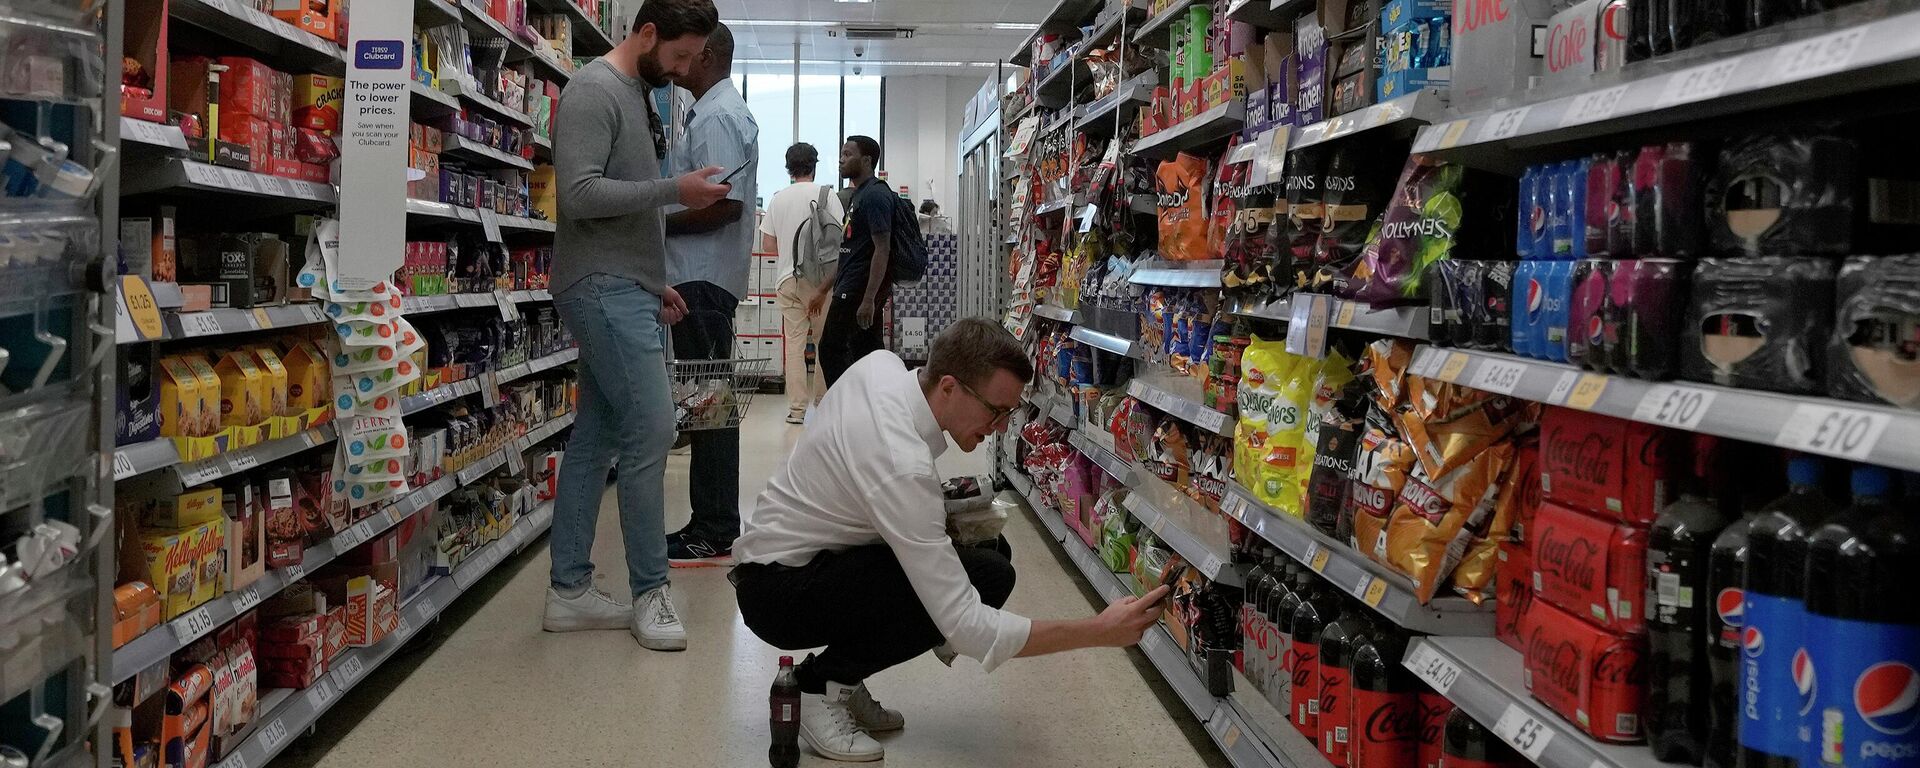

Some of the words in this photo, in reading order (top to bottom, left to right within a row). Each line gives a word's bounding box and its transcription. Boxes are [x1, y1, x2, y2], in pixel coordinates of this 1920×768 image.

[363, 52, 395, 60] Clubcard
[1548, 16, 1587, 73] Coke
[350, 80, 369, 90] The
[372, 81, 406, 91] power
[355, 93, 366, 102] to
[369, 93, 399, 103] lower
[359, 105, 396, 116] prices.
[351, 131, 364, 139] you
[383, 131, 399, 140] your
[374, 122, 394, 130] when
[358, 139, 391, 147] Clubcard.
[130, 294, 152, 310] £1.25
[195, 315, 220, 333] £1.15
[1484, 364, 1520, 389] £4.65
[1656, 389, 1703, 424] £10
[1808, 411, 1871, 451] £10
[1538, 526, 1598, 591] Coca-Cola
[239, 585, 259, 607] £1.15
[188, 609, 211, 635] £1.15
[234, 656, 256, 683] nutella
[1425, 657, 1457, 689] £4.70
[214, 671, 235, 700] nutella
[316, 684, 329, 701] £1
[1745, 658, 1761, 721] pepsi
[266, 722, 286, 746] £1.15
[1513, 717, 1543, 750] £5
